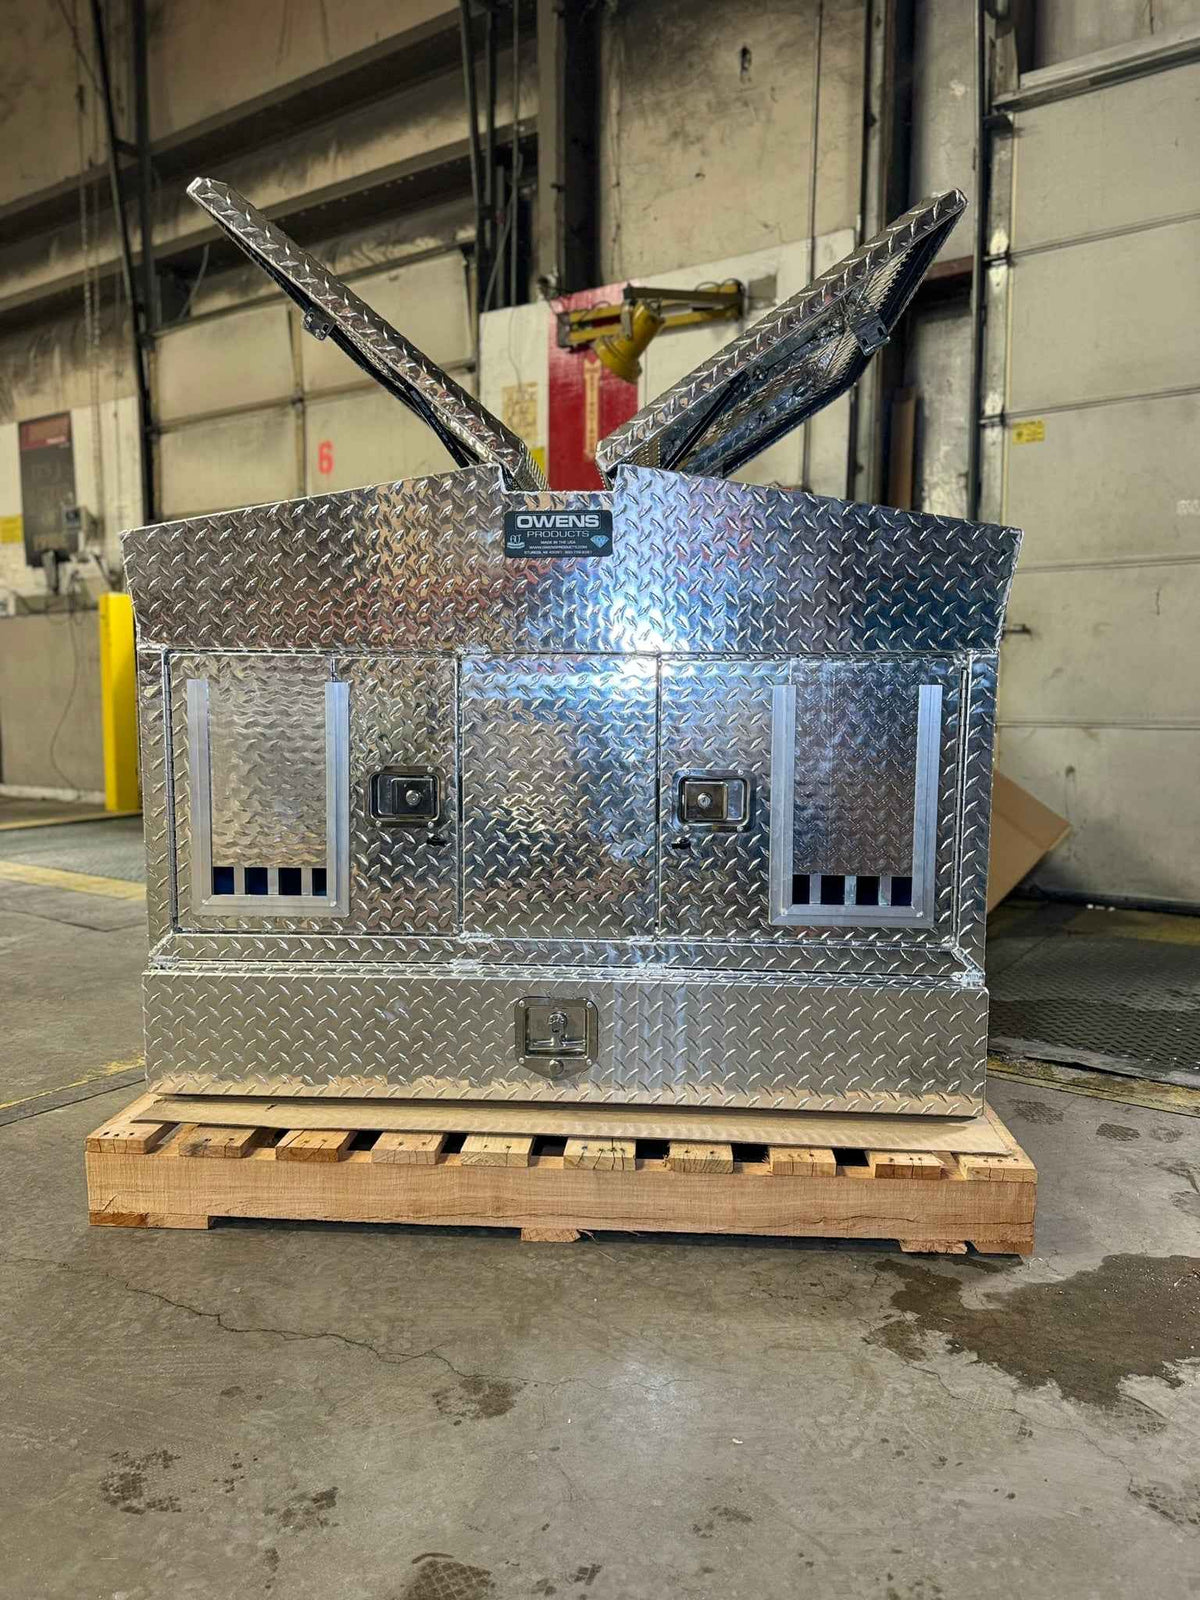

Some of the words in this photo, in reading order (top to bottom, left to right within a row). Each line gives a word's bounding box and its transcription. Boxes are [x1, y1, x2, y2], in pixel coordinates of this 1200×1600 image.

[318, 440, 334, 475] 6
[516, 514, 600, 528] OWENS
[526, 530, 590, 538] PRODUCTS
